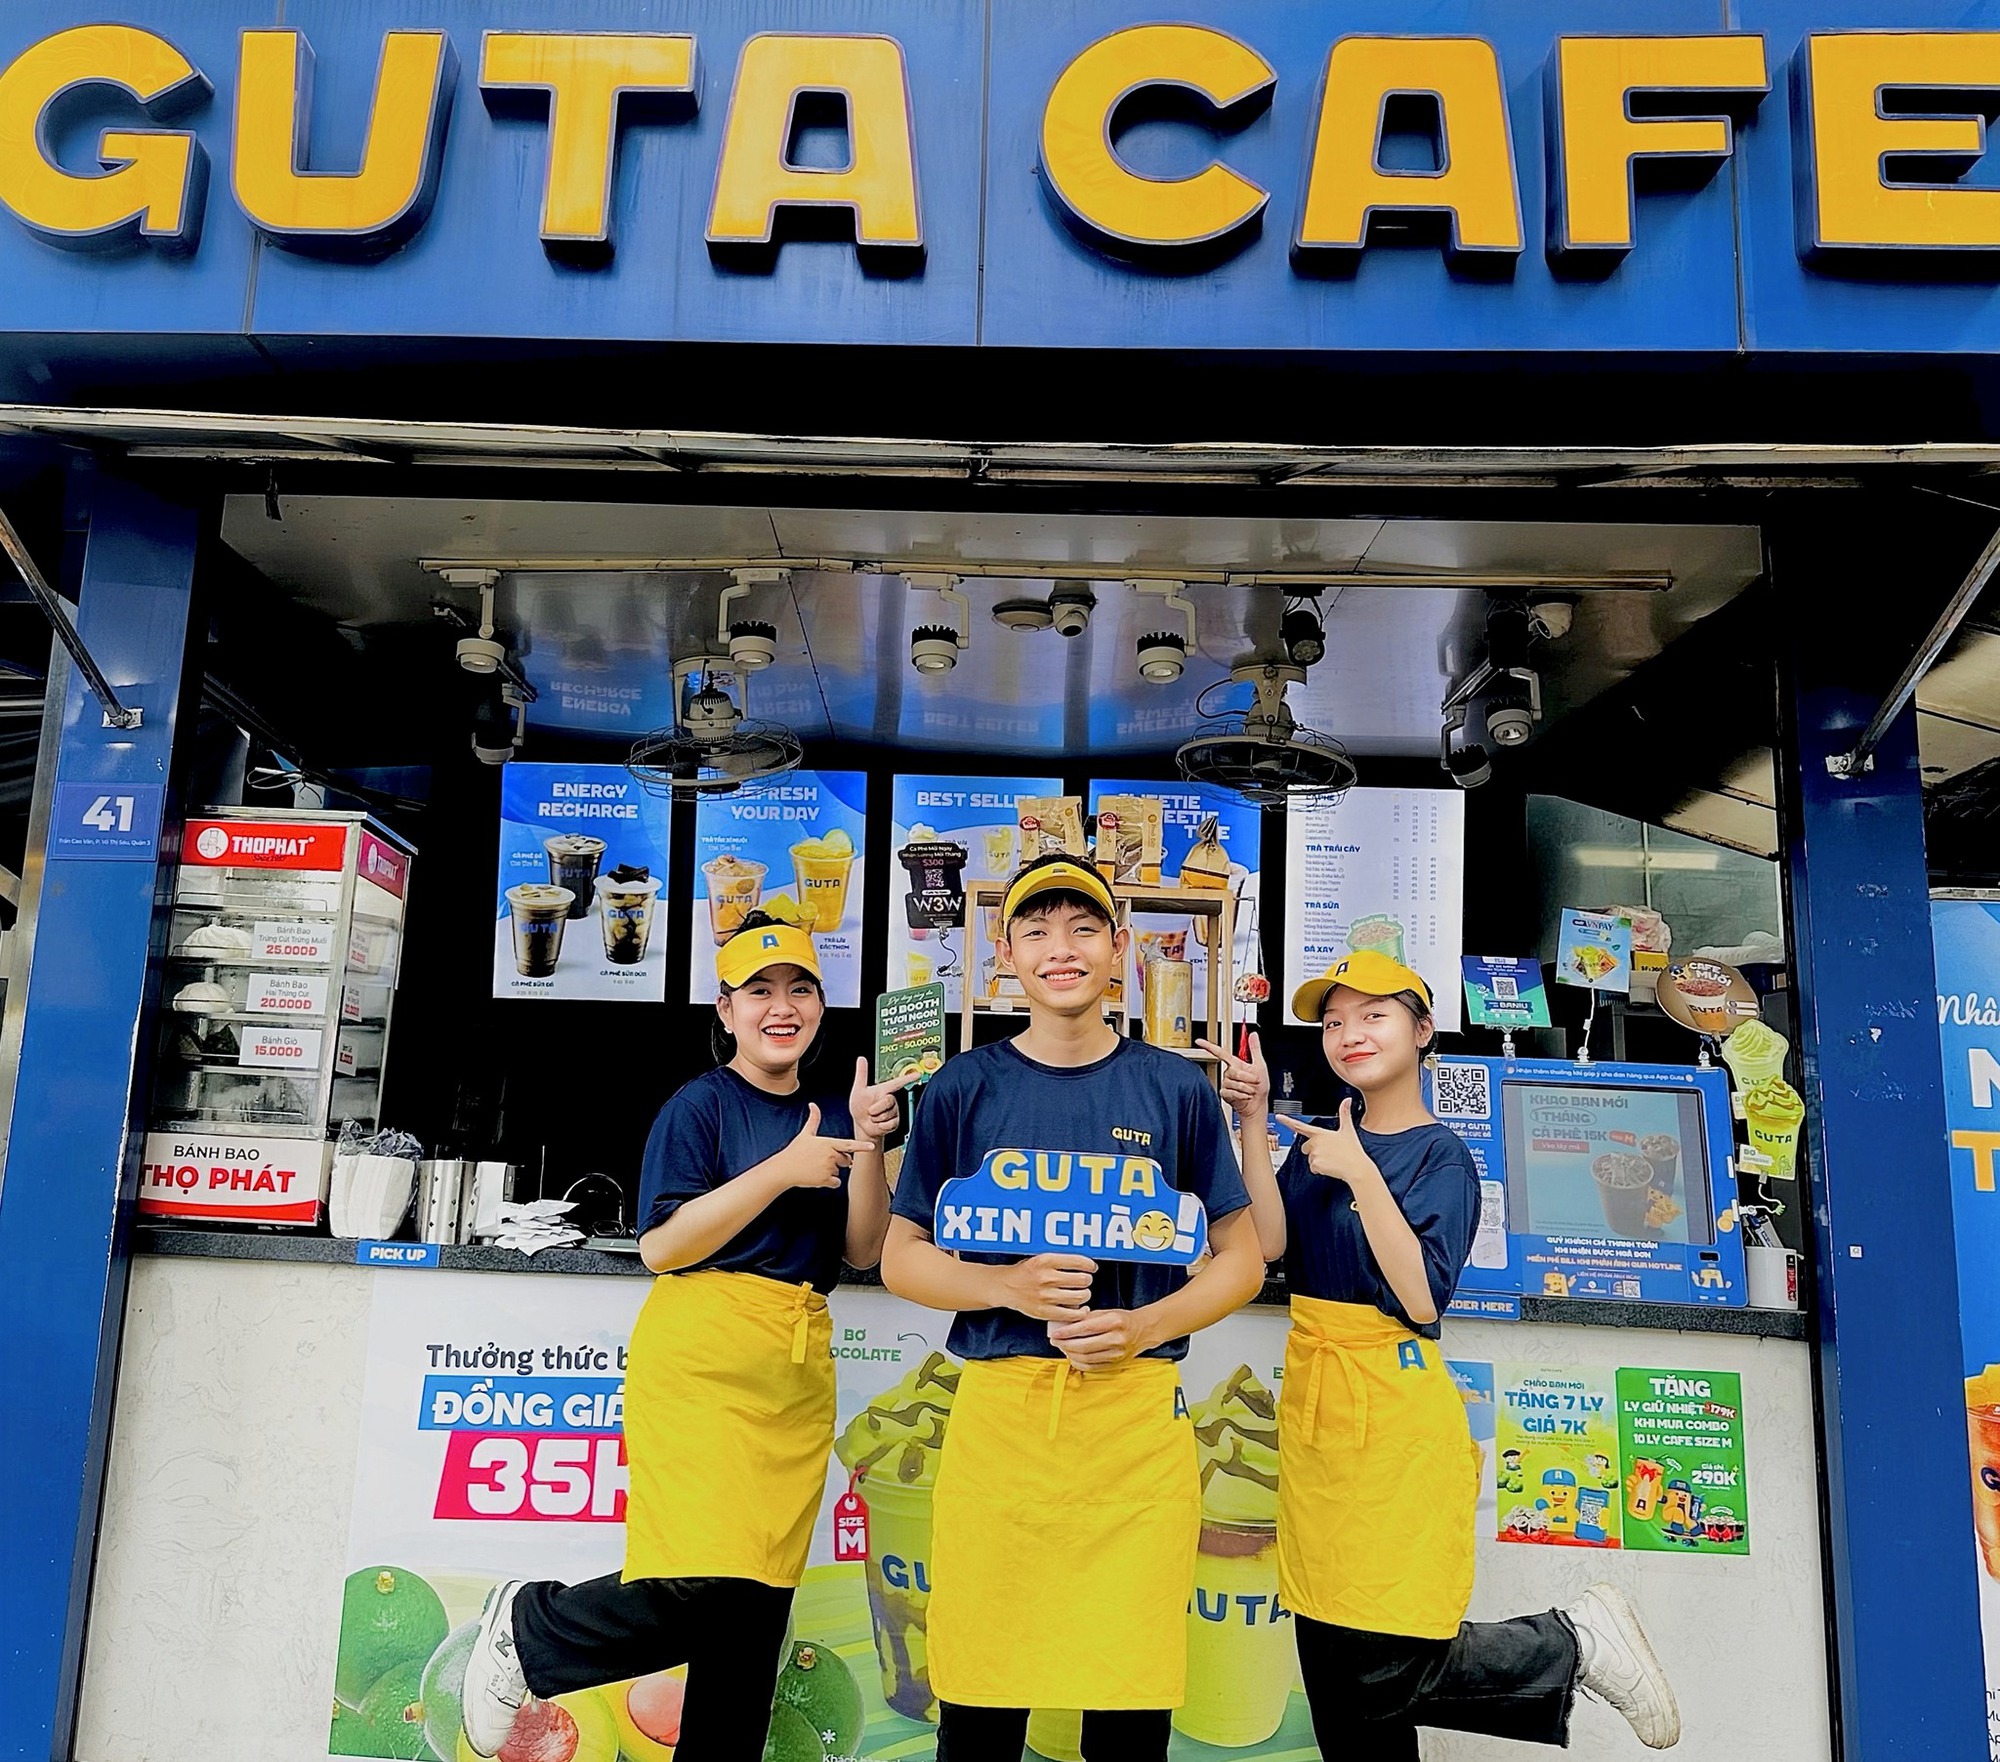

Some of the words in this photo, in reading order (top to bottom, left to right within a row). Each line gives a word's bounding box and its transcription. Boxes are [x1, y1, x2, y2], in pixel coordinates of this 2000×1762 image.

[0, 22, 926, 250] GUTA
[1038, 22, 2000, 252] CAFE
[552, 782, 628, 800] ENERGY
[917, 791, 967, 807] BEST
[82, 796, 135, 832] 41
[538, 802, 638, 820] RECHARGE
[731, 805, 780, 820] YOUR
[783, 806, 820, 821] DAY
[804, 878, 841, 889] GUTA
[716, 895, 753, 904] GUTA
[913, 896, 963, 913] W3W
[608, 909, 644, 919] GUTA
[276, 926, 295, 934] Bánh
[296, 927, 311, 935] Bao
[762, 934, 779, 949] A
[266, 944, 317, 956] 25.000Đ
[1335, 961, 1349, 976] A
[1688, 962, 1721, 974] CAFE
[270, 979, 290, 988] Bánh
[292, 980, 308, 989] Bao
[260, 998, 312, 1009] 20.000Đ
[898, 997, 940, 1014] BOOTH
[1688, 1004, 1723, 1014] GUTA
[908, 1008, 938, 1022] NGON
[882, 1027, 899, 1037] 1KG
[262, 1035, 282, 1044] Bánh
[254, 1045, 303, 1057] 15.000Đ
[880, 1043, 899, 1054] 2KG
[1602, 1096, 1629, 1108] MỚI
[1542, 1110, 1591, 1123] THÁNG
[1450, 1122, 1466, 1130] APP
[1467, 1123, 1492, 1131] GUTA
[1111, 1126, 1151, 1146] GUTA
[1532, 1127, 1550, 1138] CÀ
[1553, 1127, 1582, 1140] PHÊ
[1583, 1131, 1608, 1141] 15K
[1754, 1129, 1792, 1143] GUTA
[173, 1142, 220, 1159] BÁNH
[224, 1147, 260, 1161] BAO
[141, 1163, 199, 1195] THỌ
[208, 1163, 296, 1193] PHÁT
[990, 1151, 1157, 1199] GUTA
[943, 1204, 1033, 1244] XIN
[369, 1247, 405, 1261] PICK
[406, 1248, 427, 1261] UP
[1648, 1262, 1682, 1271] HOTLINE
[1447, 1300, 1479, 1310] RDER
[1481, 1301, 1514, 1312] HERE
[844, 1328, 866, 1341] BƠ
[426, 1341, 534, 1376] Thưởng
[541, 1344, 608, 1371] thức
[830, 1346, 902, 1362] OCOLATE
[1398, 1339, 1428, 1371] A
[1523, 1378, 1548, 1387] CHÀO
[1549, 1381, 1567, 1389] BẠN
[1568, 1380, 1585, 1390] MỚI
[1649, 1374, 1712, 1399] TẶNG
[432, 1378, 554, 1426] ĐỒNG
[563, 1384, 625, 1427] GIÁ
[1504, 1388, 1559, 1410] TẶNG
[1563, 1395, 1575, 1410] 7
[1580, 1396, 1604, 1411] LY
[1624, 1400, 1640, 1412] LY
[1642, 1399, 1665, 1413] GIỮ
[1666, 1401, 1705, 1417] NHIỆT
[1710, 1403, 1736, 1419] 179K
[1523, 1414, 1556, 1434] GIÁ
[1561, 1419, 1588, 1436] 7K
[1634, 1417, 1655, 1428] KHI
[1656, 1418, 1684, 1430] MUA
[1685, 1420, 1730, 1432] COMBO
[1633, 1433, 1646, 1444] 10
[1647, 1434, 1660, 1445] LY
[1662, 1435, 1693, 1447] CAFE
[1694, 1436, 1721, 1448] SIZE
[1721, 1438, 1733, 1449] M
[1554, 1470, 1563, 1480] A
[1691, 1470, 1738, 1486] 290K
[1636, 1498, 1647, 1511] A
[838, 1516, 866, 1528] SIZE
[838, 1528, 868, 1556] M
